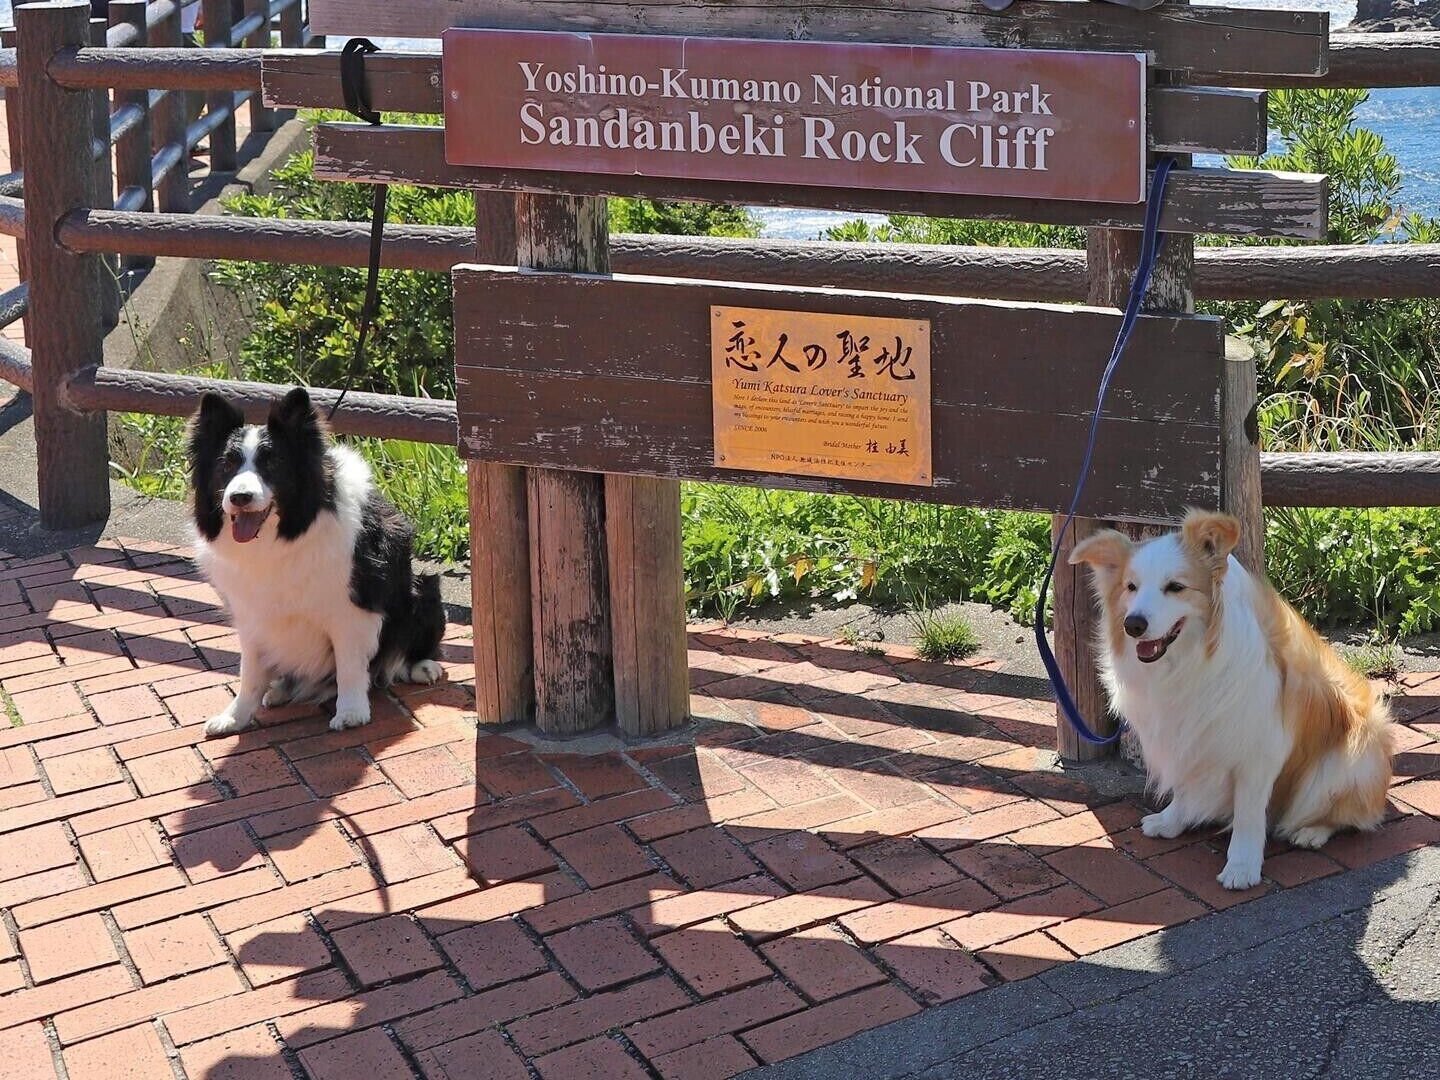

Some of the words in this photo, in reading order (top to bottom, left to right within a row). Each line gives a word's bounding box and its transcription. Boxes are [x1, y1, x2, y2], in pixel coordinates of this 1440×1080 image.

[517, 60, 801, 104] Yoshino-Kumano
[811, 74, 956, 112] National
[967, 81, 1053, 117] Park
[519, 103, 785, 157] Sandanbeki
[801, 116, 923, 165] Rock
[939, 122, 1055, 172] Cliff
[725, 320, 917, 381] 恋人の聖地
[732, 378, 761, 391] Yumi
[763, 381, 808, 395] Katsura
[810, 385, 850, 399] Lover's
[851, 388, 908, 407] Sanctuary
